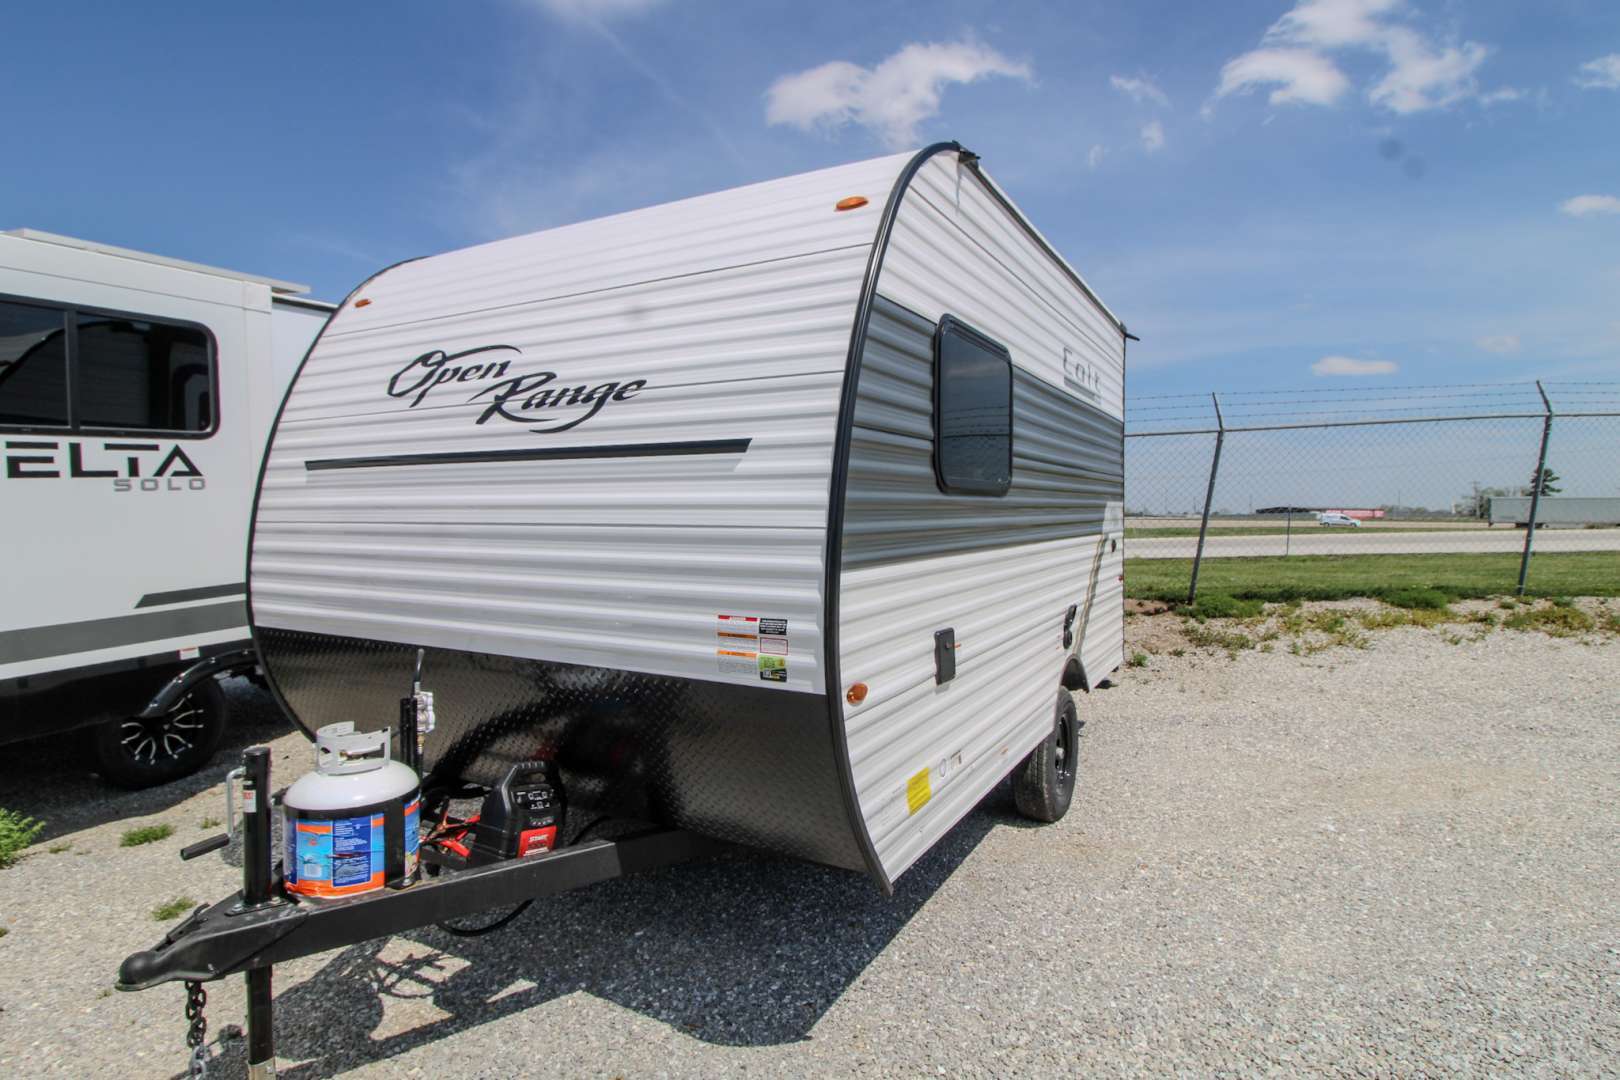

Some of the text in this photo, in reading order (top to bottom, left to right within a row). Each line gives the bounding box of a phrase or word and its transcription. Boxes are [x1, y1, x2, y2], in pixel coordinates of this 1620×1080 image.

[387, 344, 648, 434] Open Range
[5, 441, 204, 479] ELTA
[113, 478, 206, 492] SOLO
